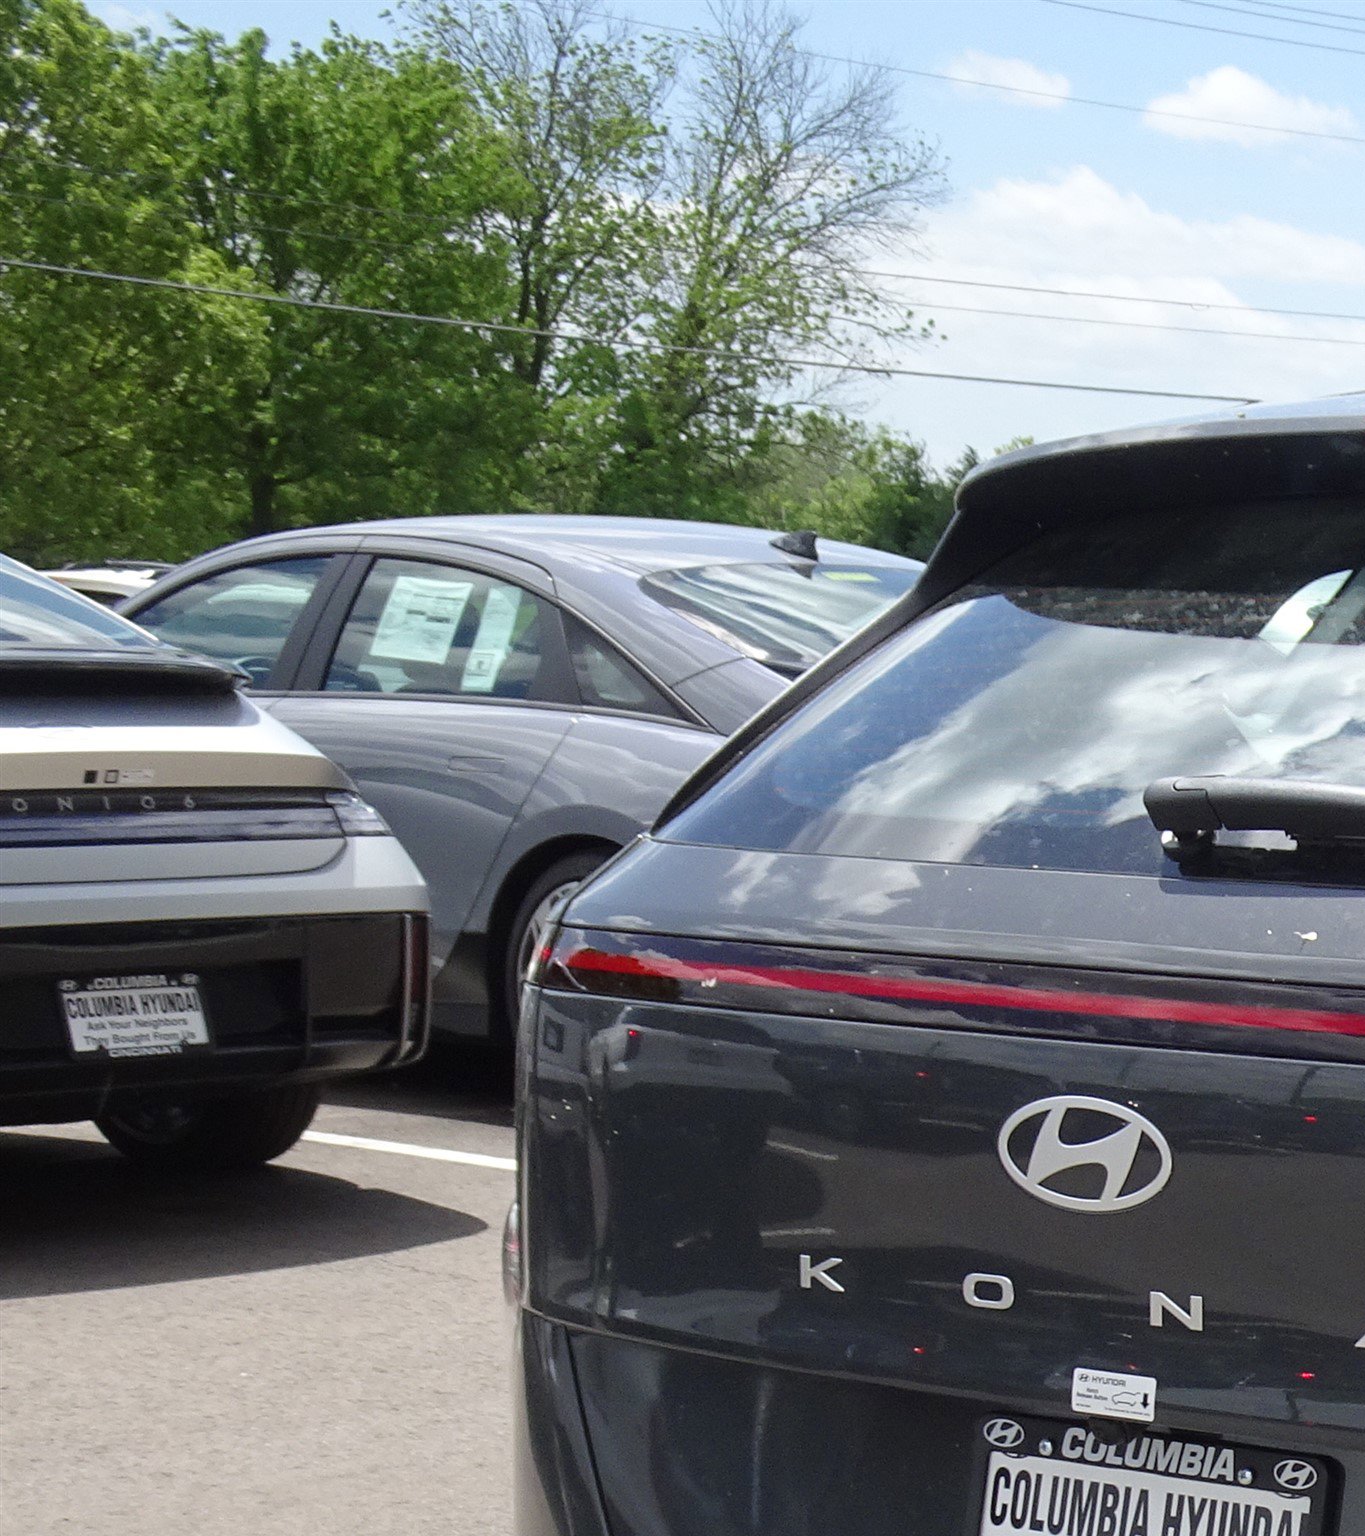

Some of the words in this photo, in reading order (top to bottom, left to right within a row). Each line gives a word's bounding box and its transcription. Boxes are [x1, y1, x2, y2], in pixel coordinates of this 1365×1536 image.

[93, 975, 168, 990] COLUMBIA
[66, 994, 139, 1018] COLUMBIA
[140, 992, 201, 1016] HYUNDAI
[87, 1021, 107, 1031] Ask
[108, 1020, 132, 1030] Your
[134, 1017, 188, 1029] Neighbors
[83, 1035, 109, 1046] They
[112, 1033, 150, 1044] Bought
[153, 1031, 180, 1041] From
[1091, 1376, 1126, 1387] HYUNDAI
